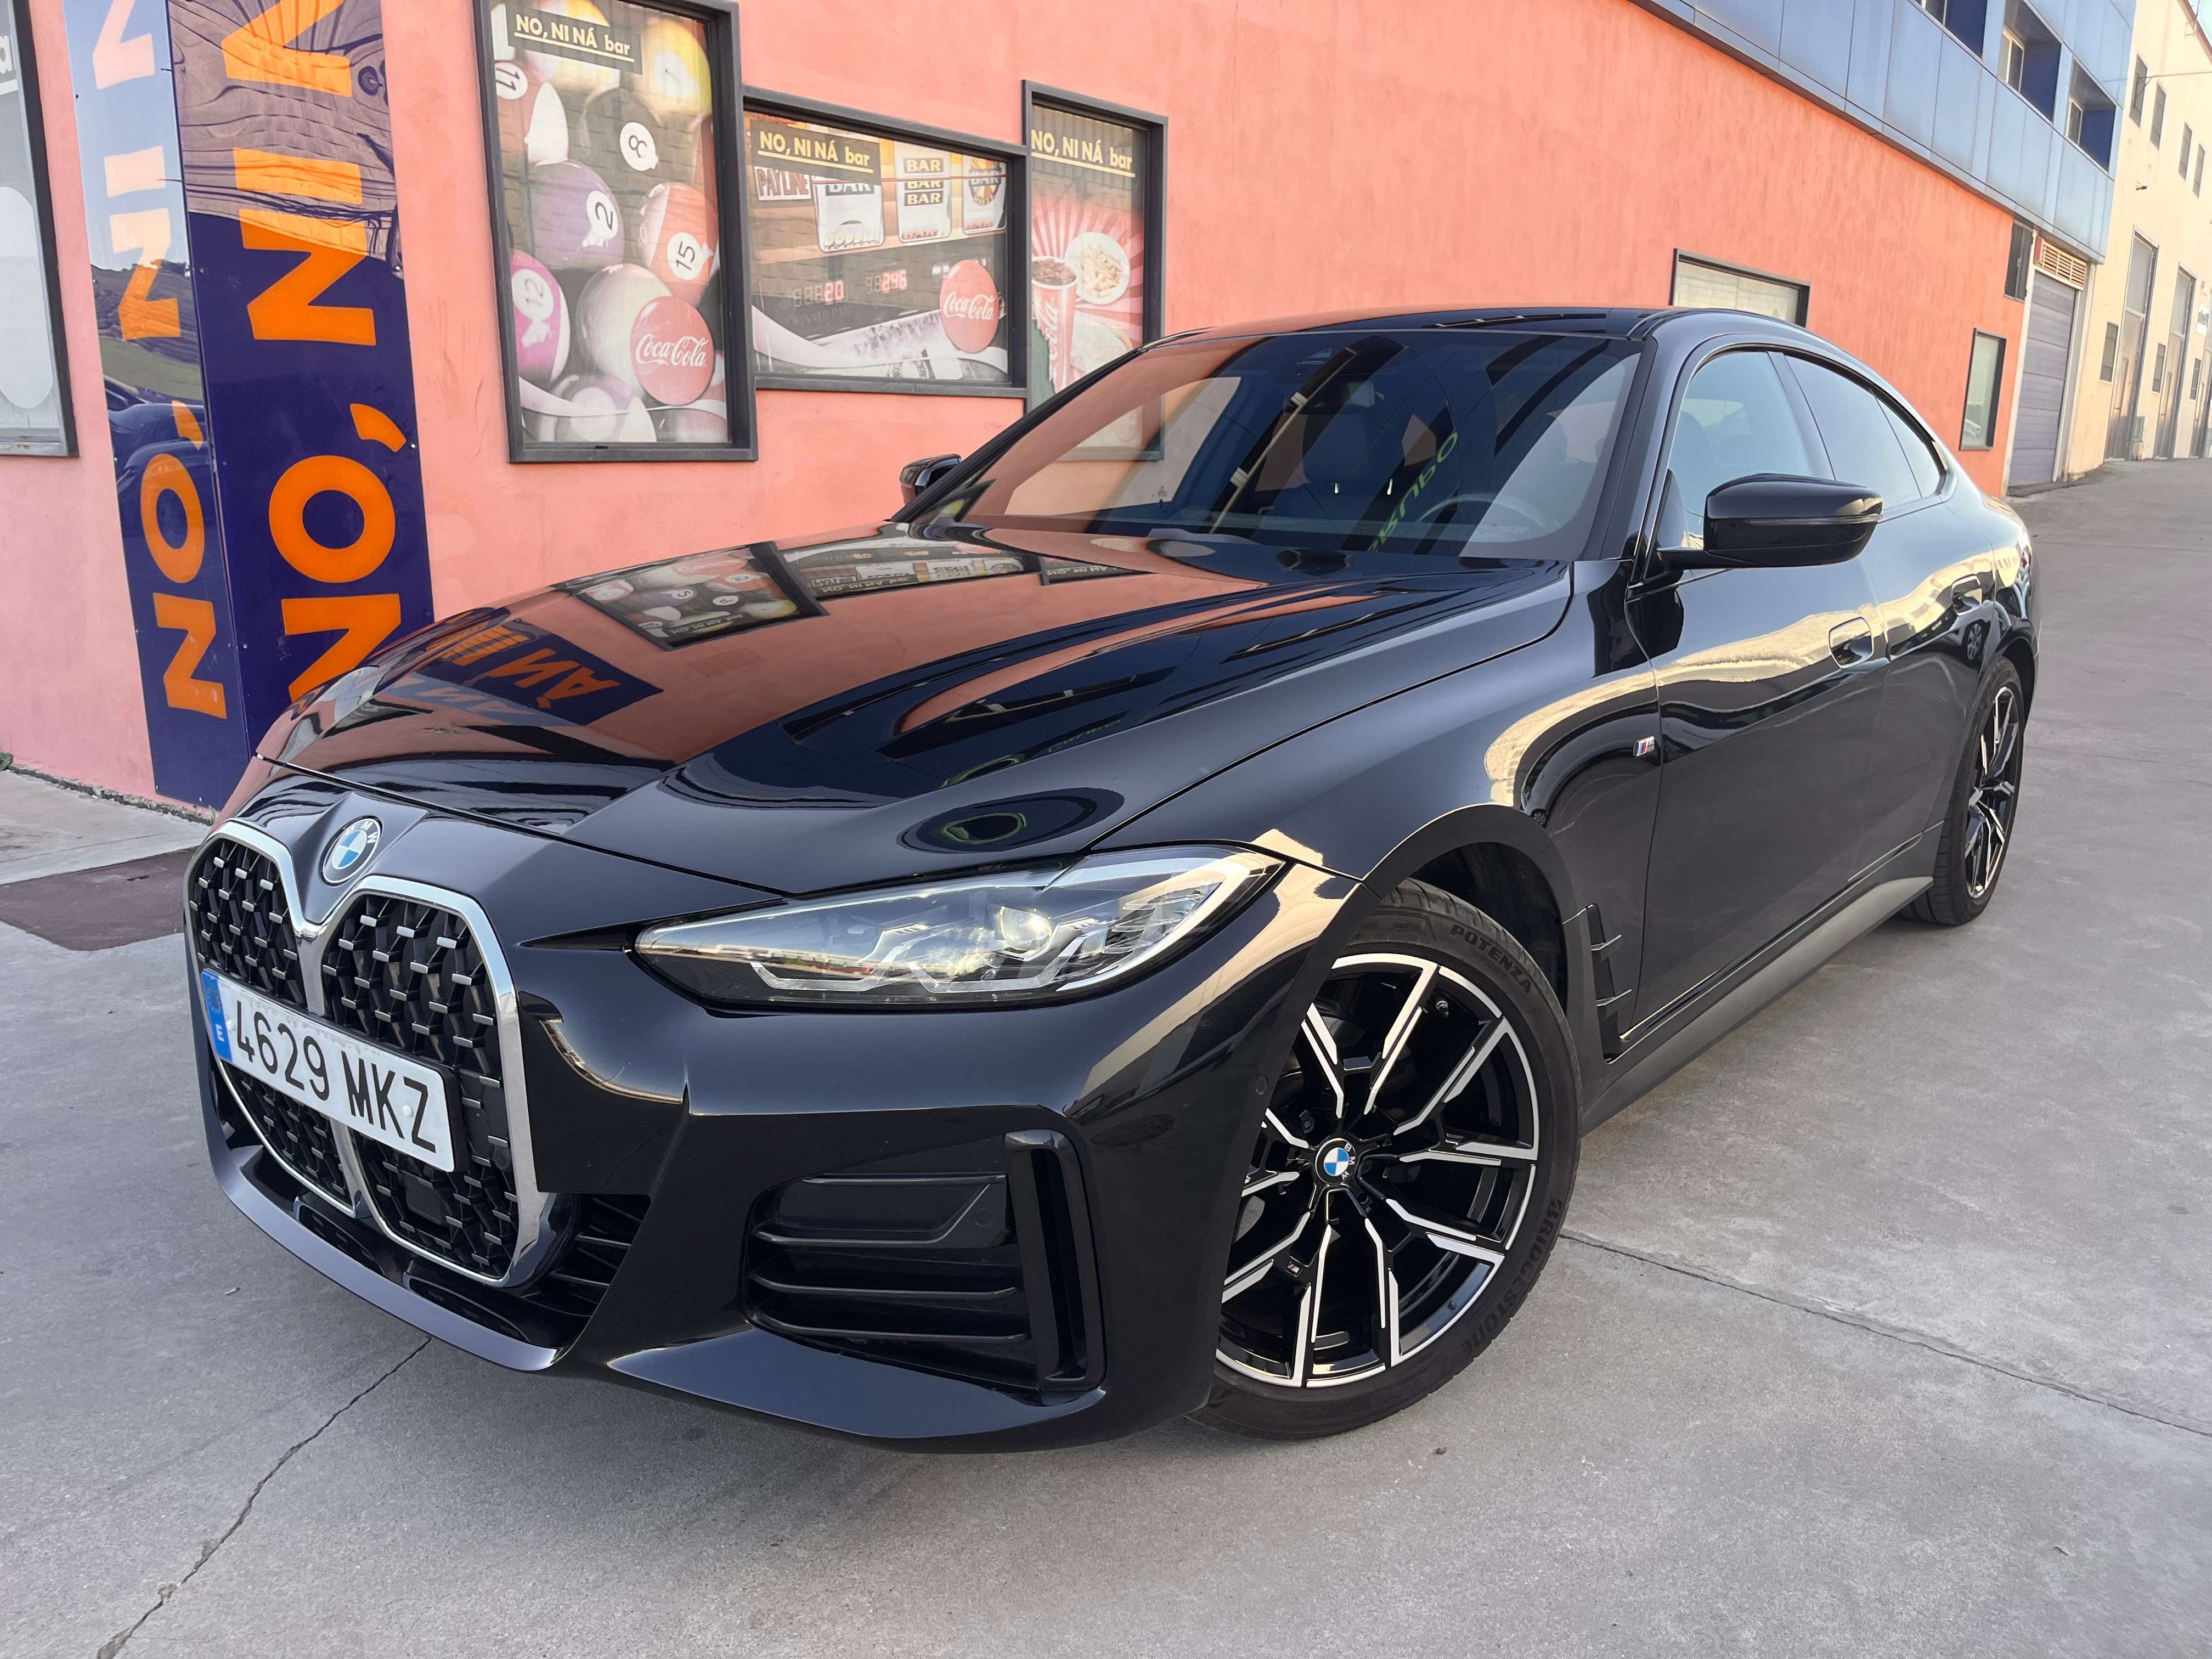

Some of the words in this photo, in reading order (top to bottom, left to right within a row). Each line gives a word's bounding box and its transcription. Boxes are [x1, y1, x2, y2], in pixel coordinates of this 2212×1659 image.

[516, 14, 548, 40] NO,
[551, 22, 569, 42] NI
[573, 27, 597, 48] NÁ
[605, 35, 630, 55] bar
[760, 131, 791, 156] NO,
[794, 137, 811, 157] NI
[815, 140, 838, 161] NÁ
[845, 146, 870, 166] bar
[1063, 136, 1079, 156] NI
[1081, 140, 1103, 164] NÁ
[1109, 147, 1132, 170] bar
[906, 159, 941, 172] BAR
[757, 168, 809, 197] PAYLINE
[907, 193, 941, 205] BAR
[595, 202, 613, 230] 2
[676, 241, 696, 271] 15
[943, 291, 996, 320] Coca-Cola
[635, 333, 709, 368] Coca-Cola
[1449, 924, 1532, 995] POTENZA
[216, 1024, 224, 1042] E
[236, 1000, 330, 1101] 4629
[341, 1050, 436, 1154] MKZ
[1341, 1142, 1356, 1180] BMW
